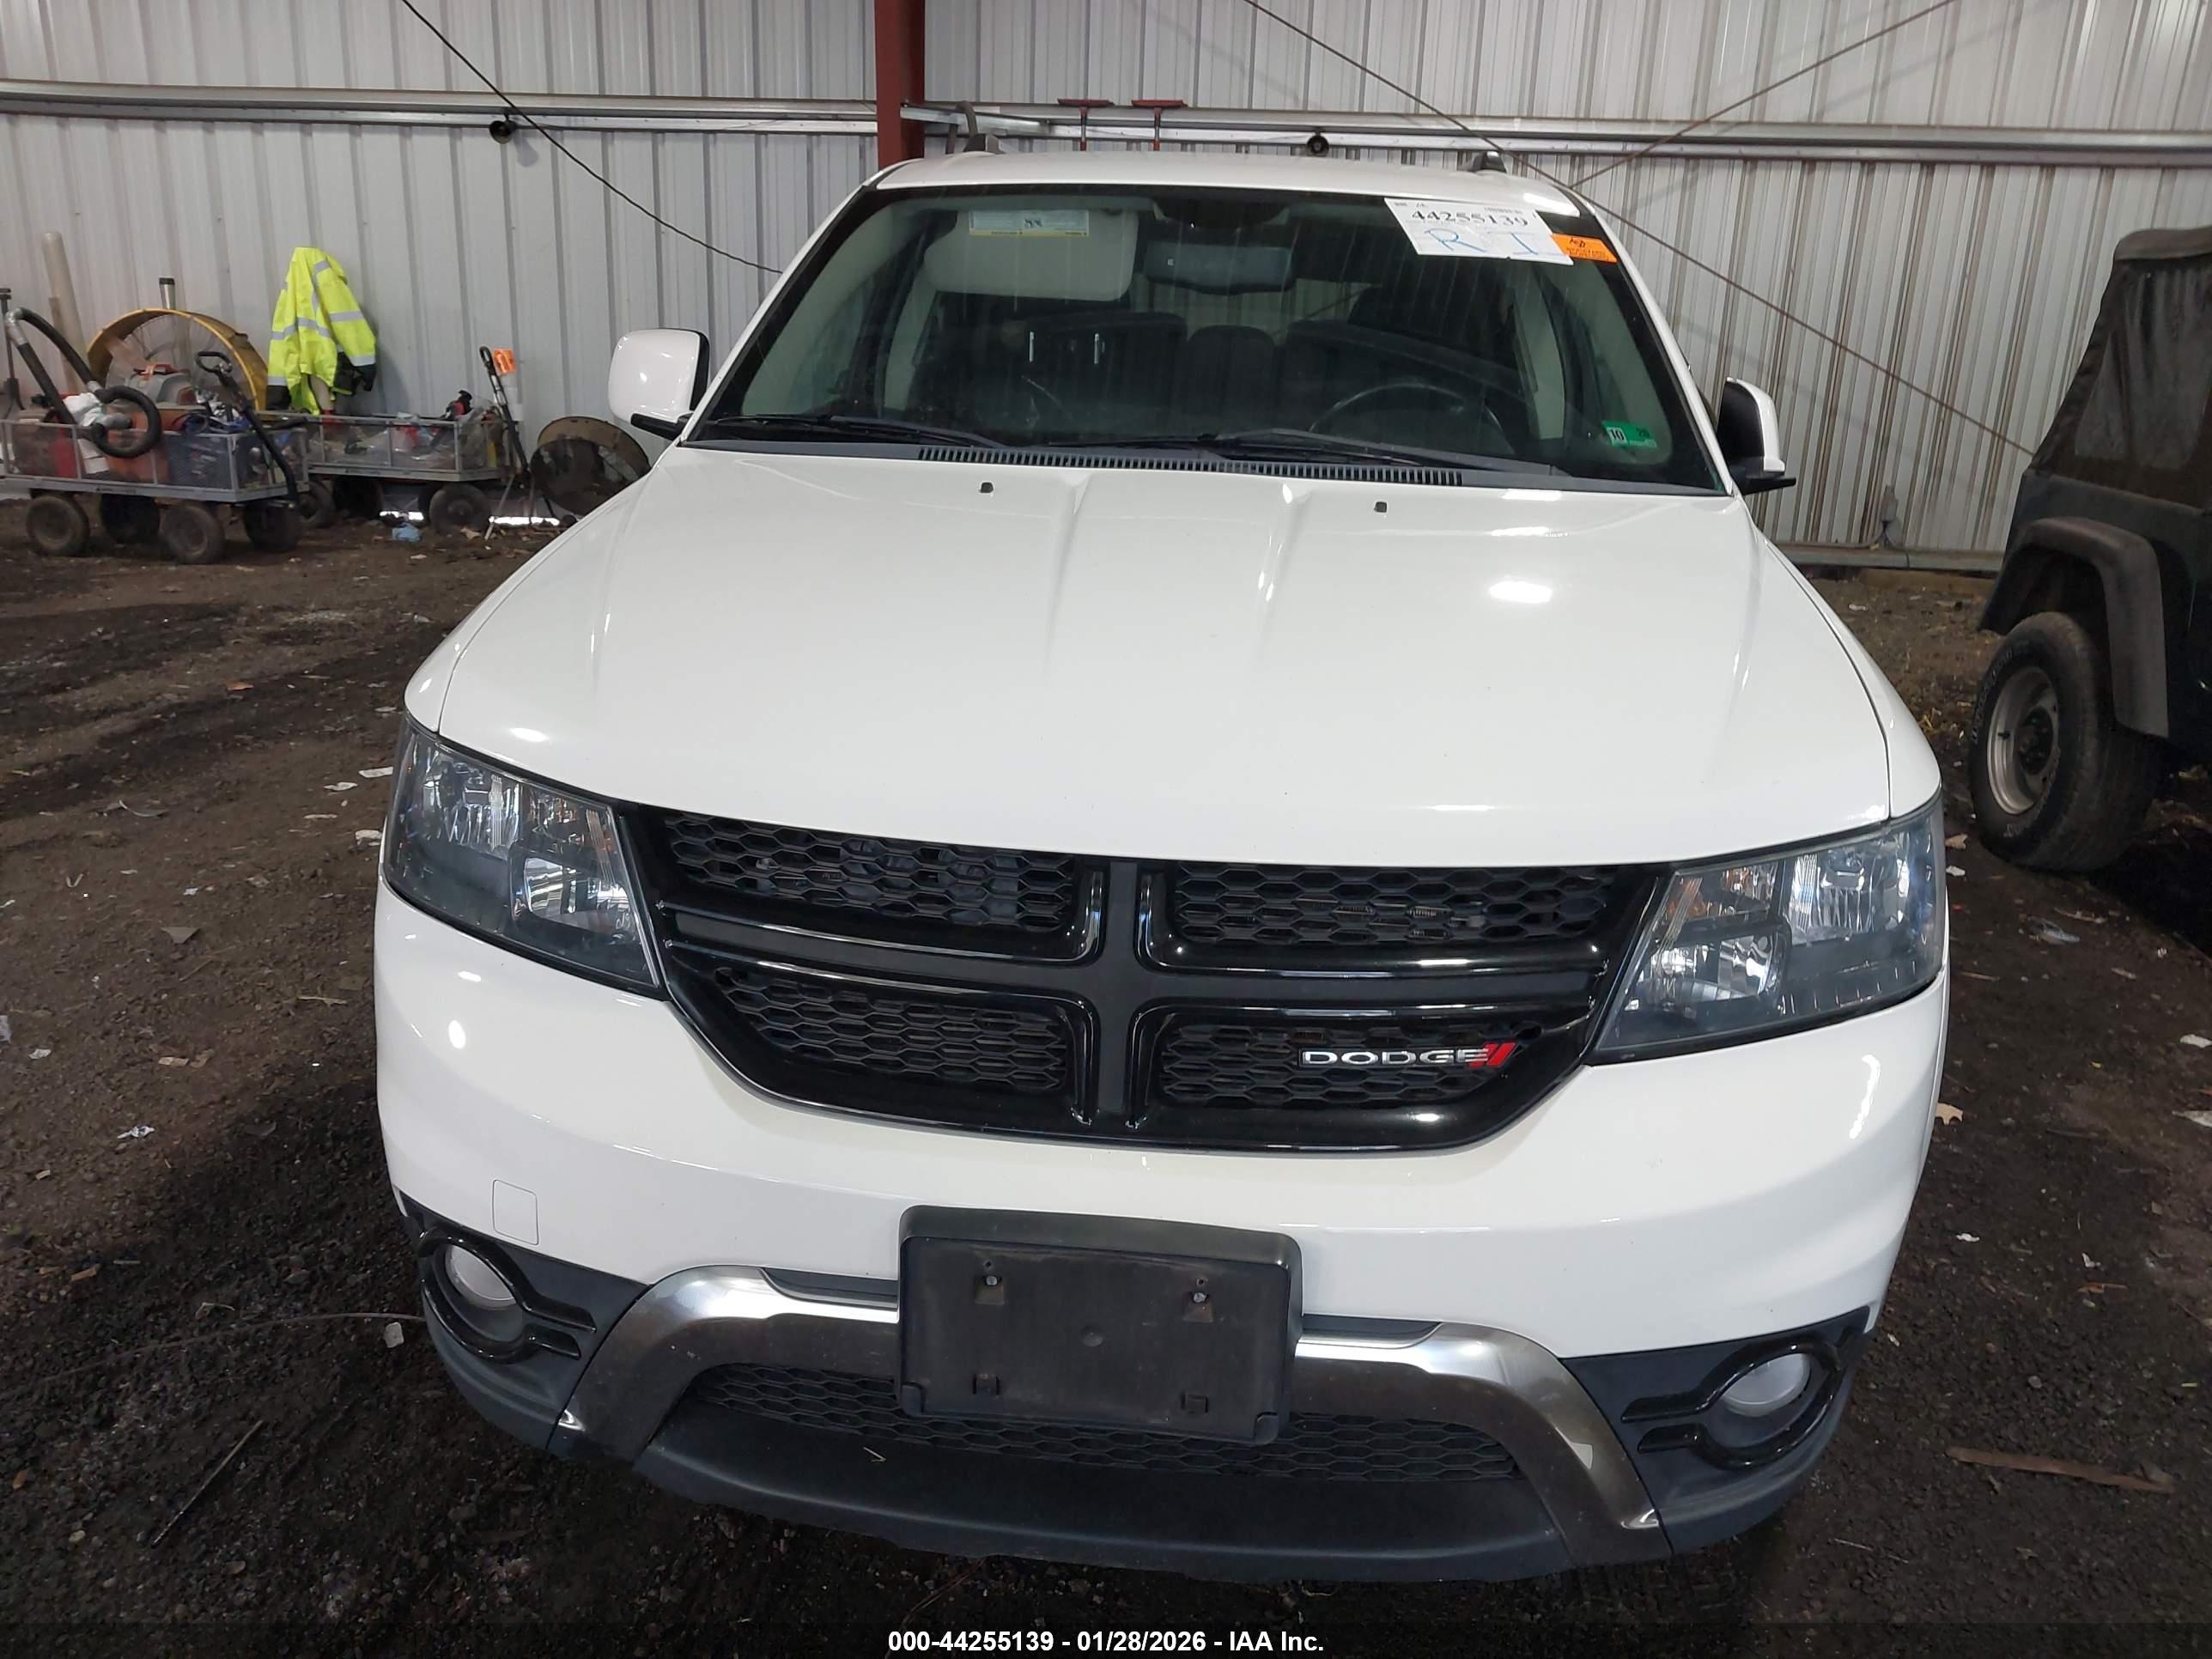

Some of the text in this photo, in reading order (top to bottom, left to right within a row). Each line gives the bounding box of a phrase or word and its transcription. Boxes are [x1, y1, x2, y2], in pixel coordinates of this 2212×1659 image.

[1412, 210, 1528, 226] 44255139
[1425, 228, 1487, 252] R
[1302, 1048, 1489, 1065] DODGE
